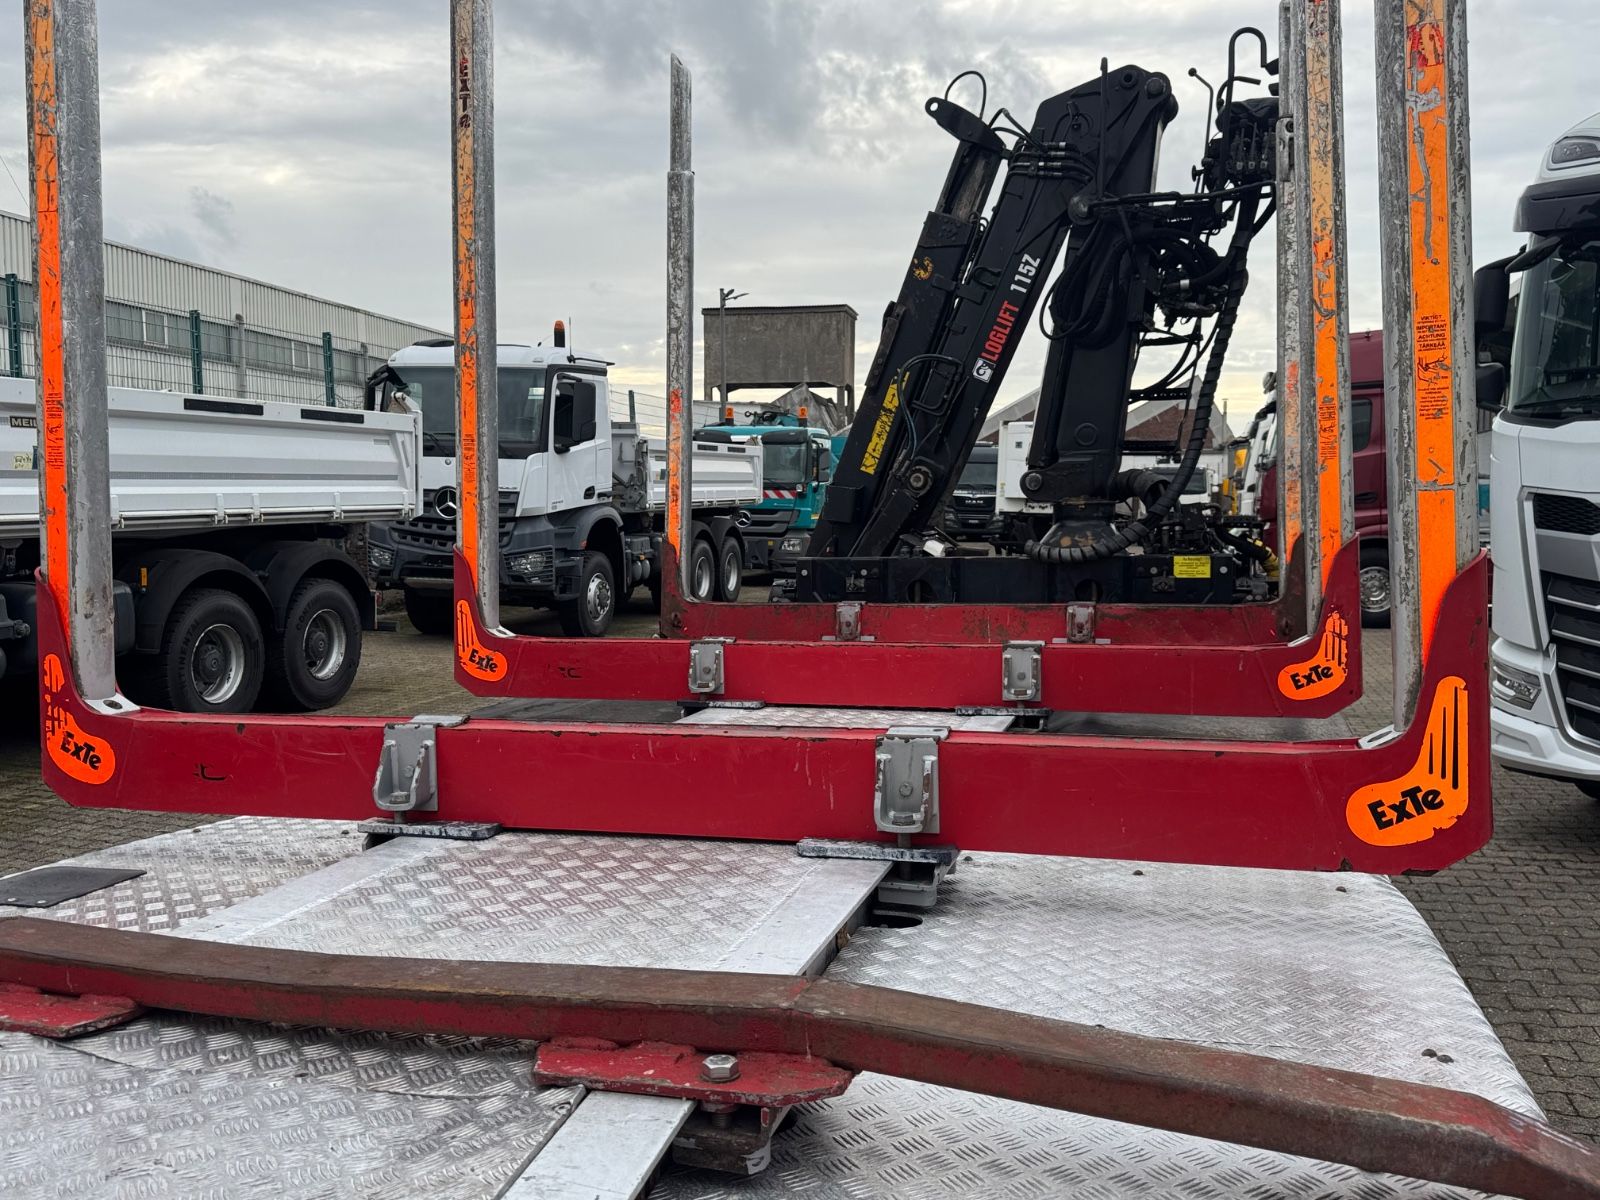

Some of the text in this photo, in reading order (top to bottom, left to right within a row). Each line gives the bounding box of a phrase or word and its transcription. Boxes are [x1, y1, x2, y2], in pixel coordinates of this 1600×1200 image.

[980, 253, 1041, 363] LOGLIFT 115Z
[468, 647, 498, 674] ExTe
[1289, 665, 1334, 692] ExTe
[59, 730, 102, 772] ExTe
[1366, 786, 1445, 831] ExTe
